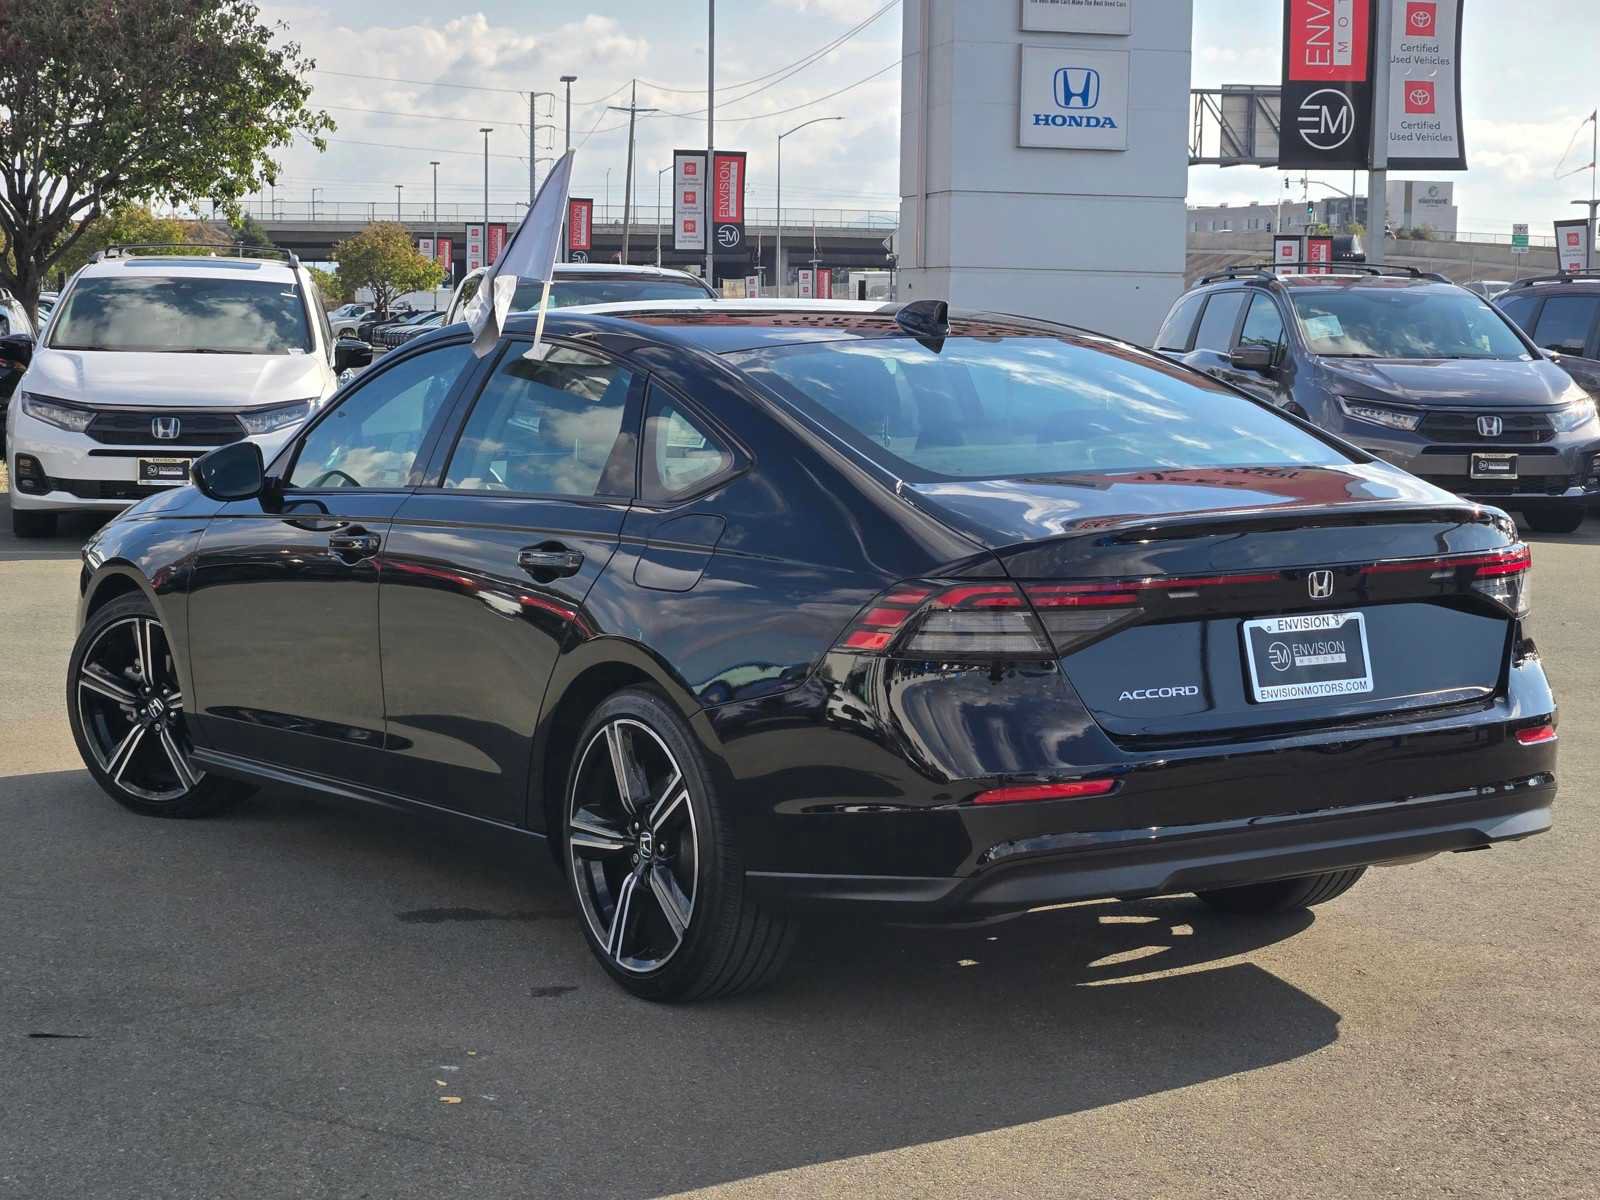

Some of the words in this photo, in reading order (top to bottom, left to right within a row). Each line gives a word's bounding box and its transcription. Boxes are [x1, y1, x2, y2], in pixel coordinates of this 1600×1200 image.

[1400, 43, 1439, 54] Certified
[1390, 55, 1411, 65] Used
[1414, 56, 1450, 66] Vehicles
[1033, 113, 1117, 129] HONDA
[1401, 120, 1440, 130] Certified
[1390, 132, 1412, 142] Used
[1414, 133, 1453, 142] Vehicles
[719, 161, 730, 217] ENVISION
[1277, 616, 1330, 631] ENVISION
[1292, 641, 1345, 657] ENVISION
[1118, 685, 1199, 702] ACCORD
[1260, 681, 1368, 700] ENVISIONMOTORS.COM
